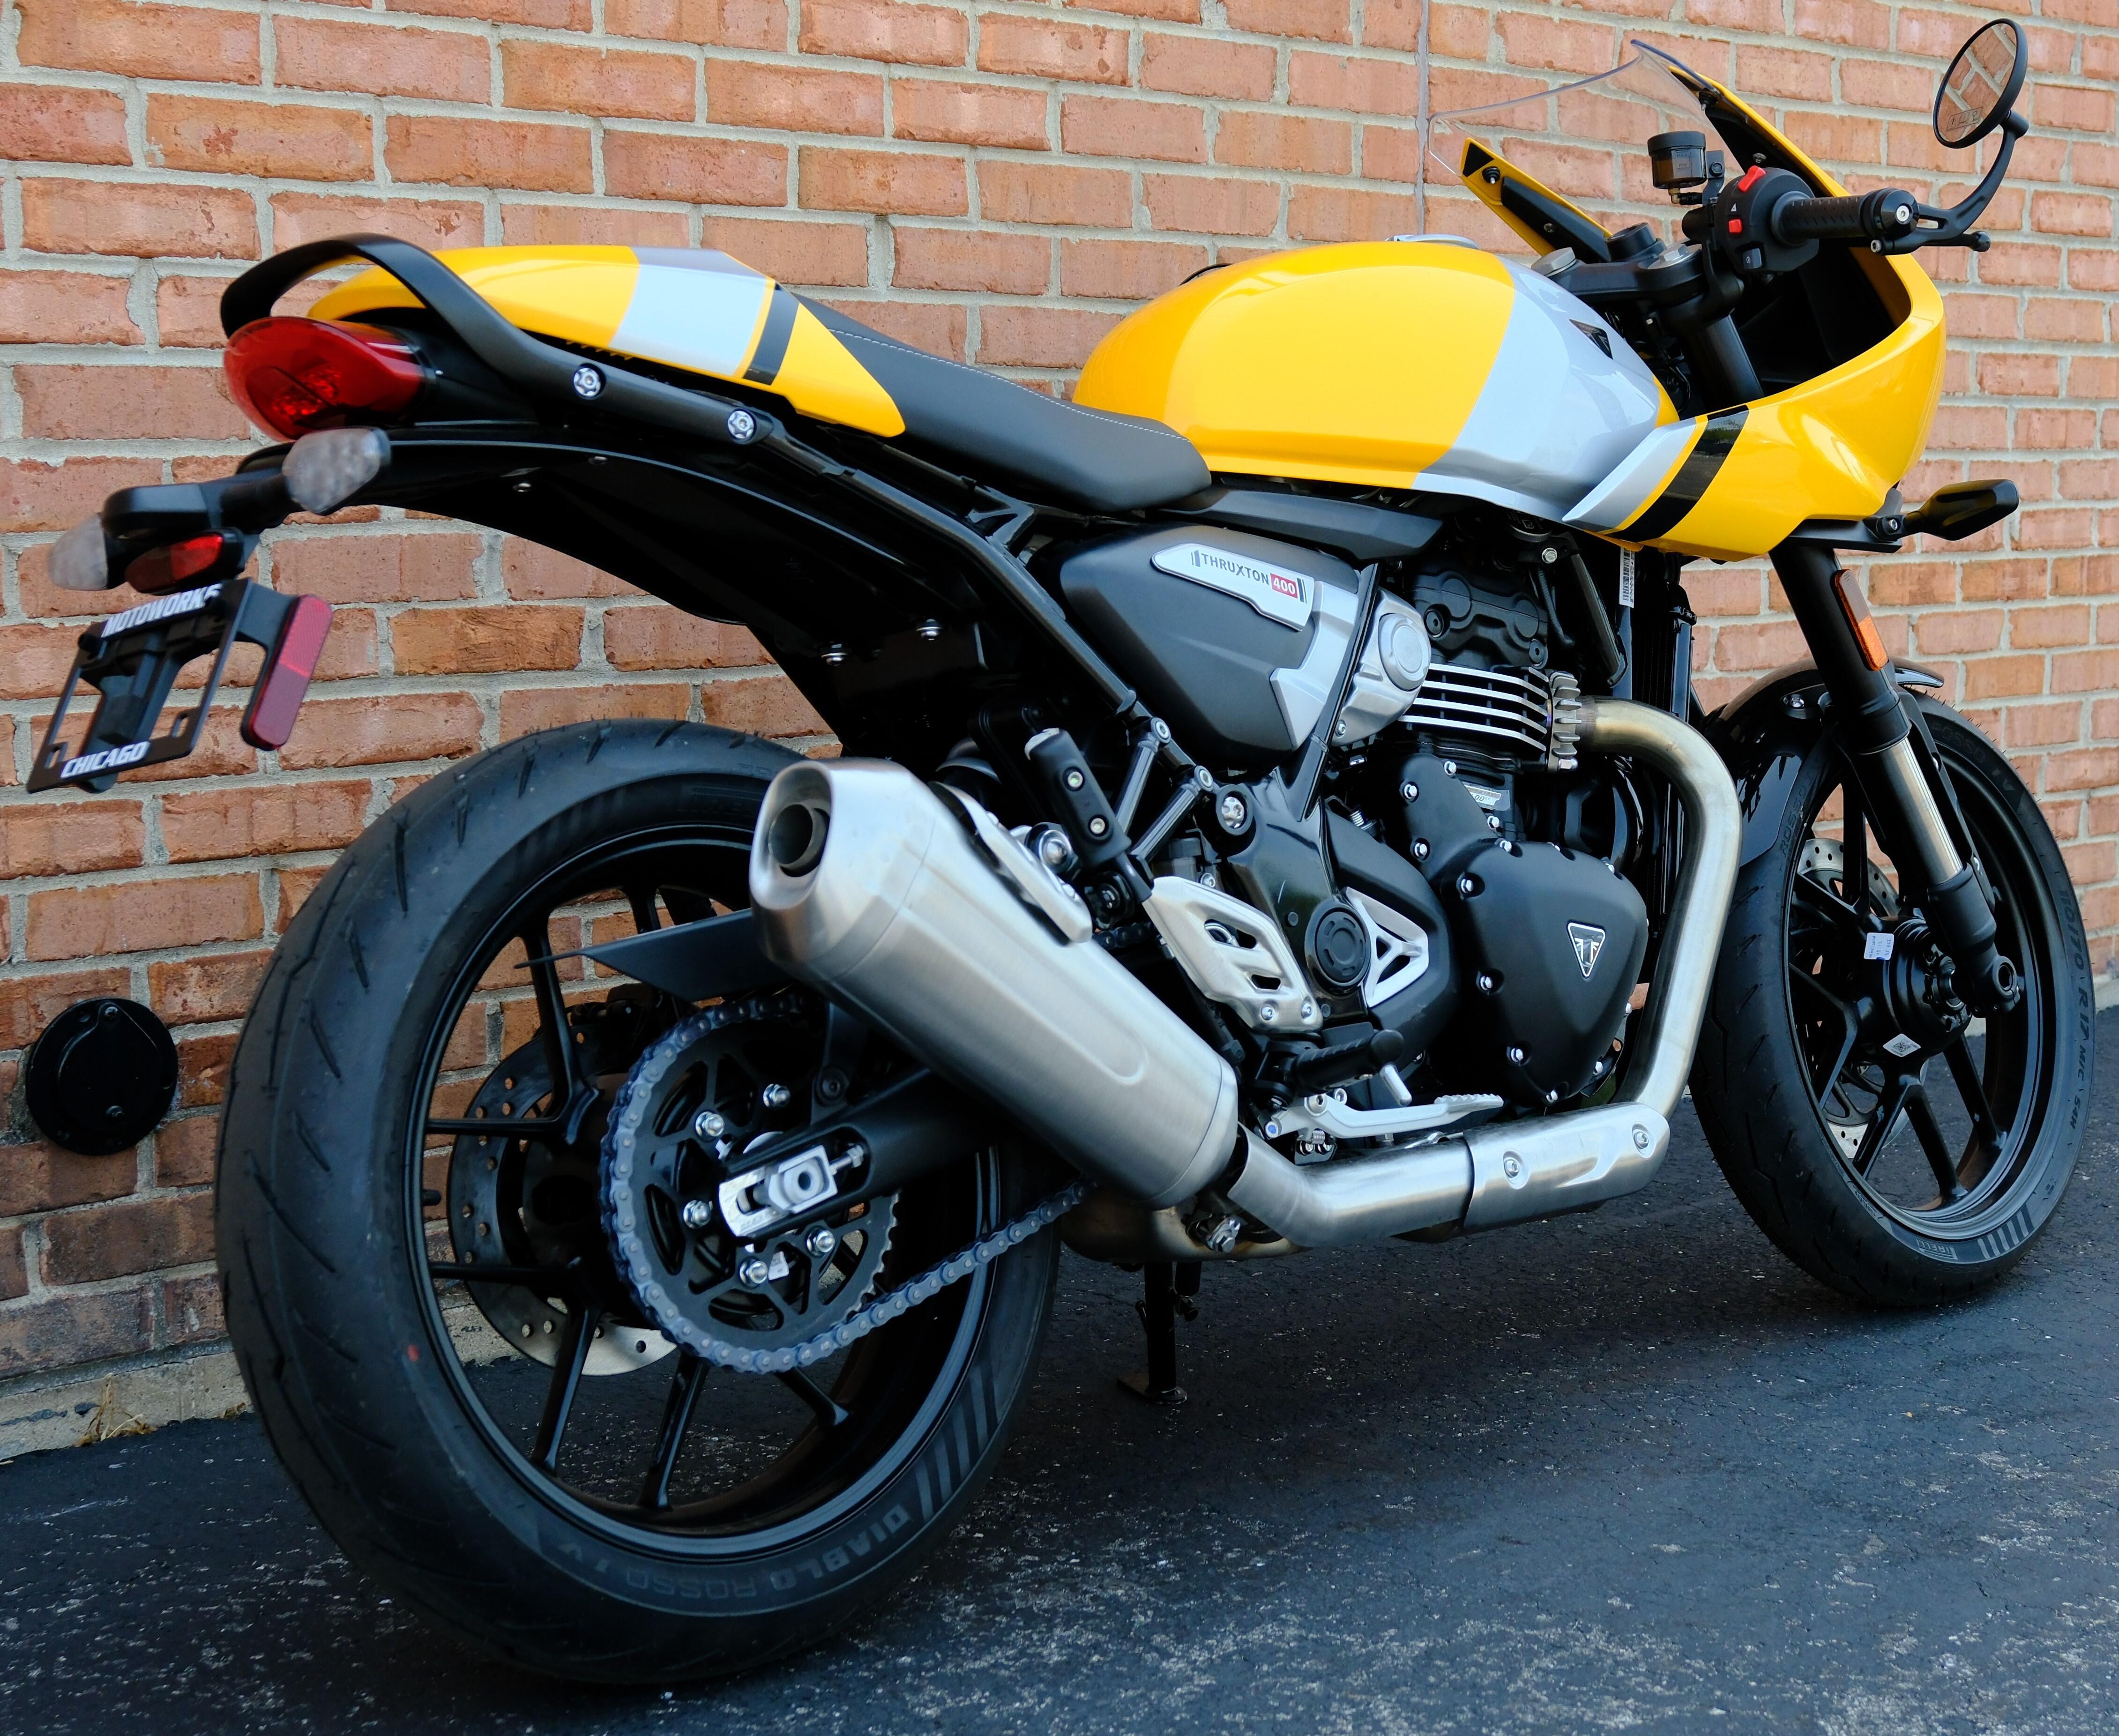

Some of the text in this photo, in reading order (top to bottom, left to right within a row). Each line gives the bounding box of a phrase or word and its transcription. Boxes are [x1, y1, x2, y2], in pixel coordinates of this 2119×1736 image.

[1201, 553, 1296, 595] THRUXTON 400
[101, 583, 222, 638] MOTOWORKS
[61, 741, 150, 779] CHICAGO
[2058, 889, 2084, 970] 110/70
[2077, 1044, 2087, 1081] M/C
[2069, 1095, 2082, 1130] 54H
[1916, 1238, 1959, 1260] PIRELLI
[560, 1505, 910, 1599] DIABLO ROSSO IV
